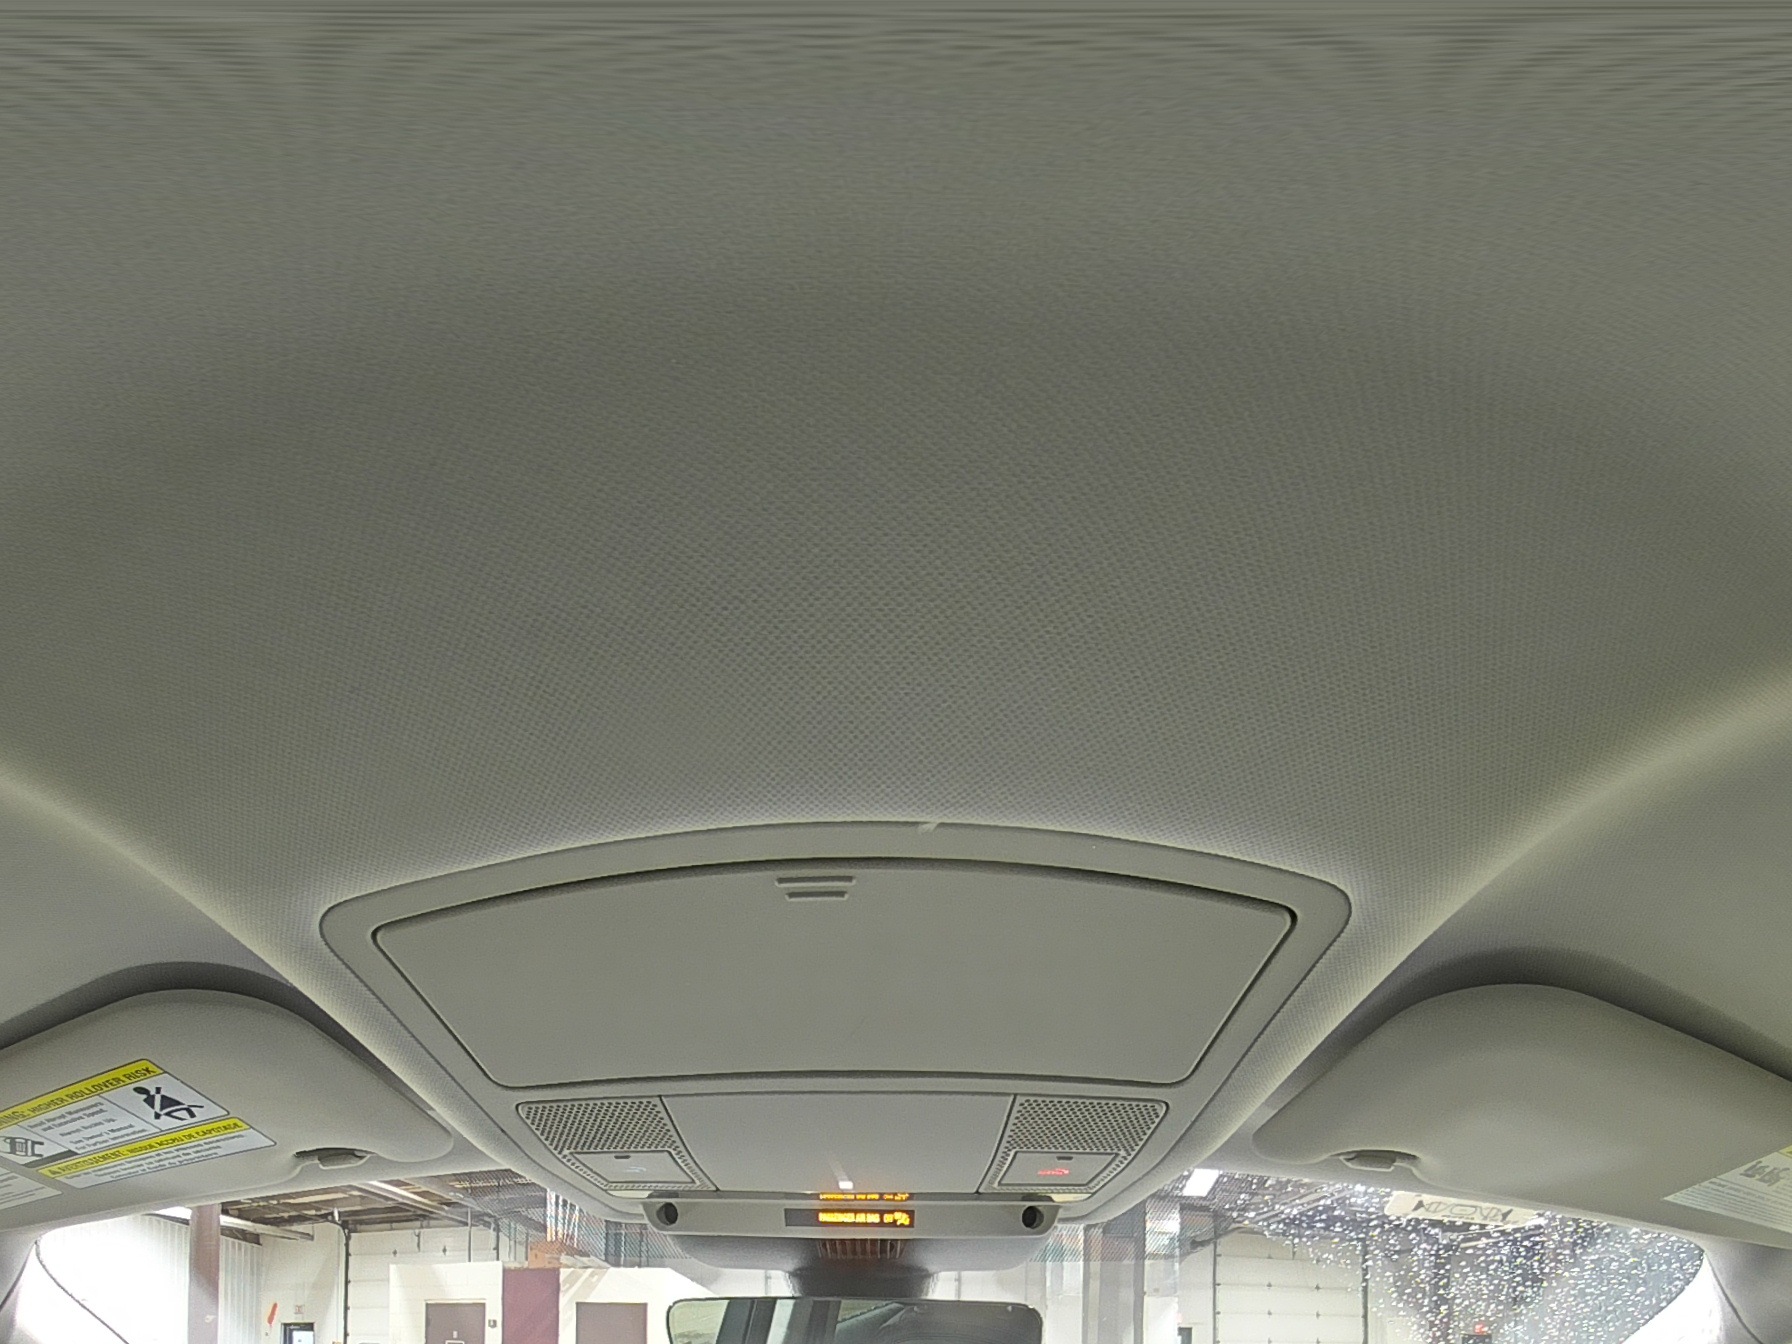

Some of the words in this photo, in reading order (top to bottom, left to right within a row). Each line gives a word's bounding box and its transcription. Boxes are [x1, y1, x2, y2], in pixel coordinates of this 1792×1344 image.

[26, 1096, 69, 1113] HIGHER
[64, 1076, 126, 1100] ROLLOVER
[121, 1066, 156, 1081] RISK
